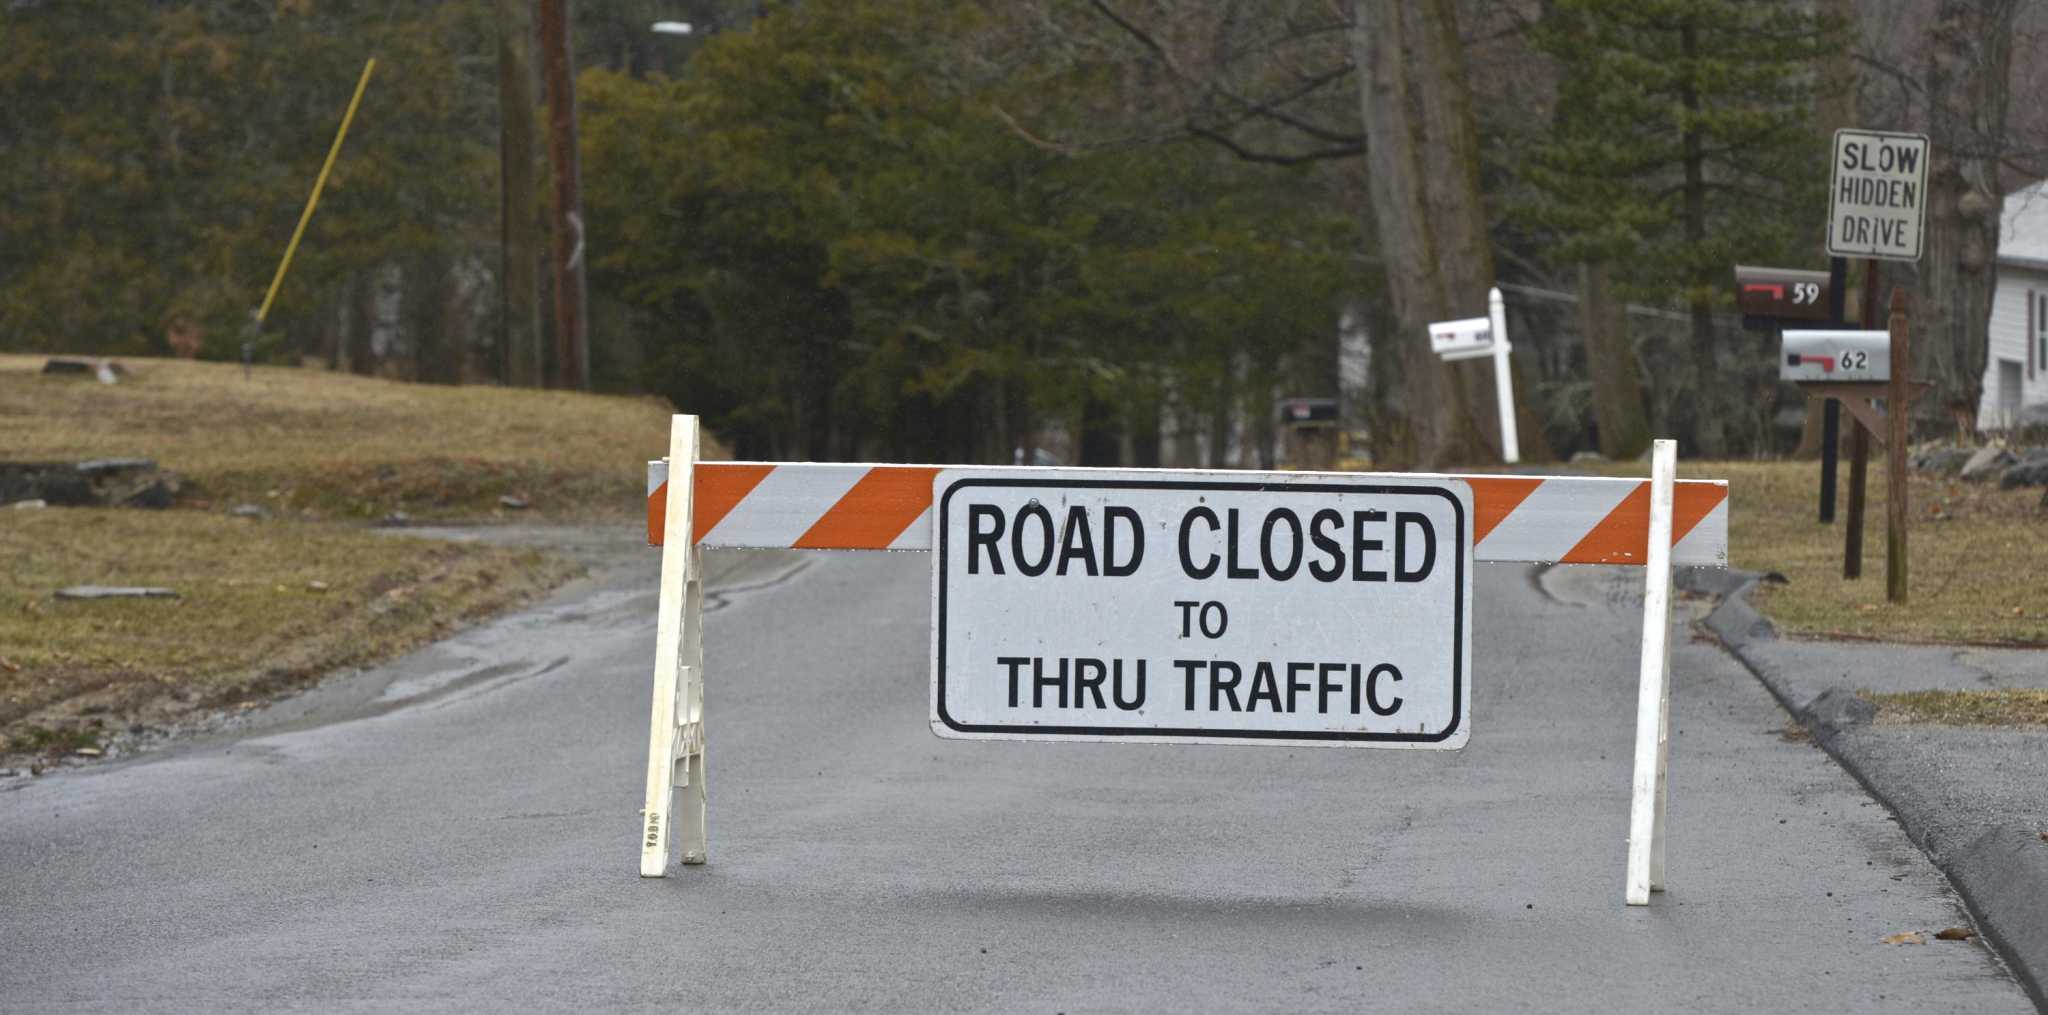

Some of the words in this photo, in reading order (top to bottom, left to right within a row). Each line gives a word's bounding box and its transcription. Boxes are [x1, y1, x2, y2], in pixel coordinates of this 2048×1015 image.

[1843, 143, 1919, 174] SLOW
[1840, 176, 1916, 208] HIDDEN
[1842, 215, 1908, 247] DRIVE
[1793, 283, 1819, 304] 59
[1841, 351, 1867, 369] 62
[968, 503, 1145, 577] ROAD
[1178, 506, 1437, 583] CLOSED
[1174, 600, 1228, 639] TO
[997, 656, 1147, 710] THRU
[1174, 659, 1404, 717] TRAFFIC
